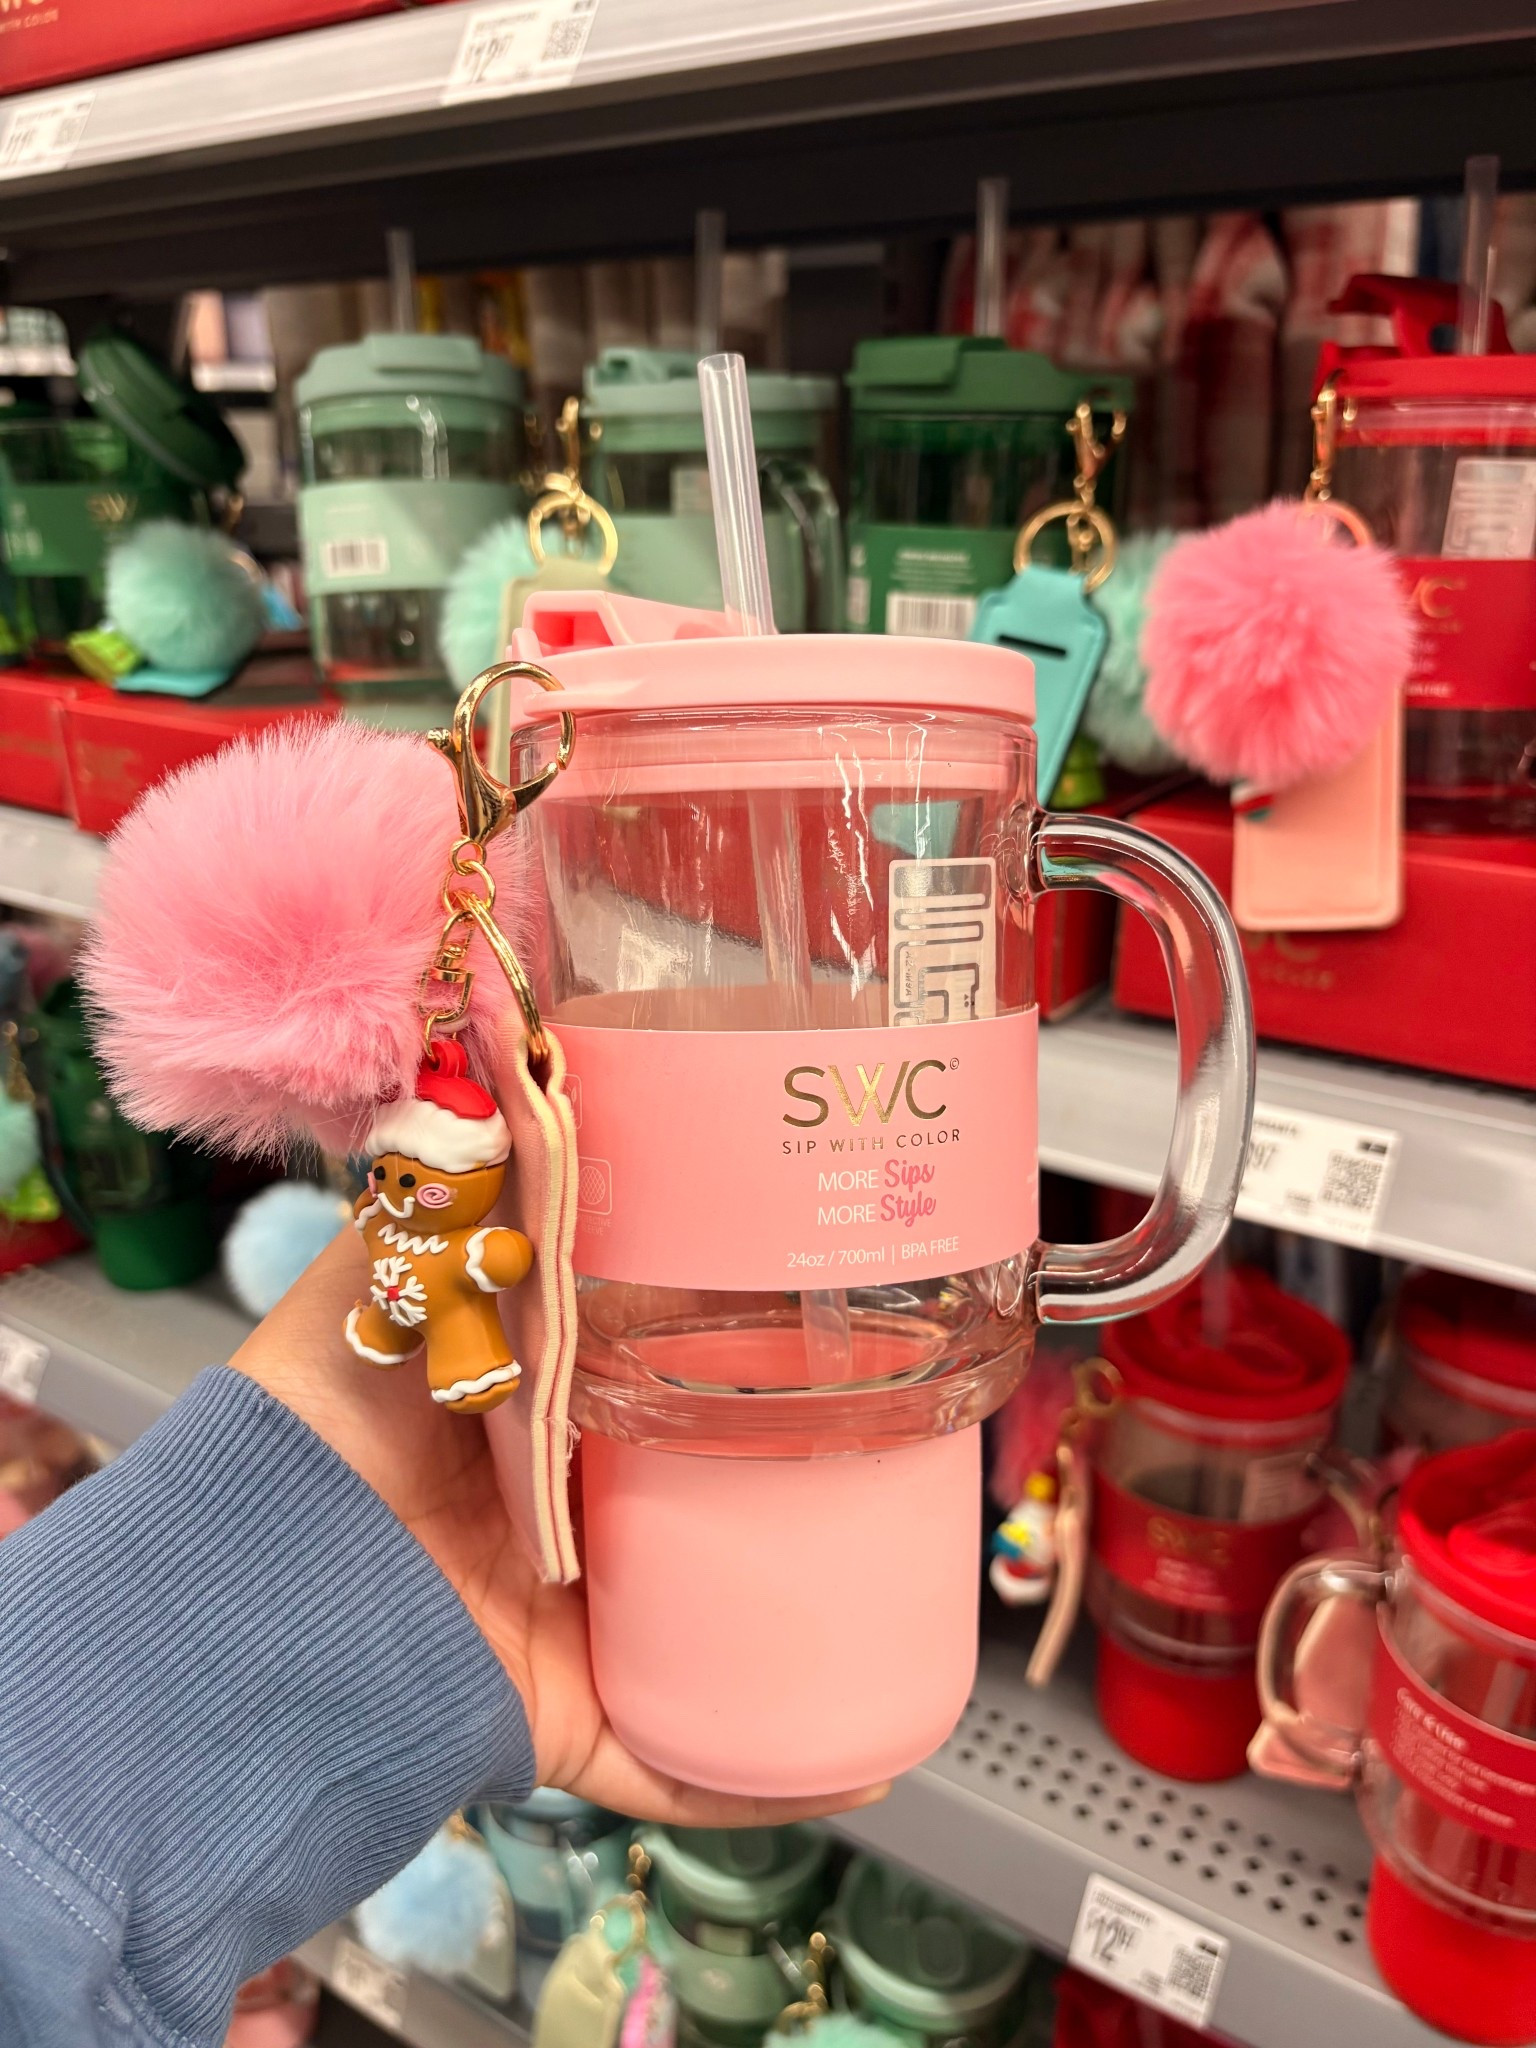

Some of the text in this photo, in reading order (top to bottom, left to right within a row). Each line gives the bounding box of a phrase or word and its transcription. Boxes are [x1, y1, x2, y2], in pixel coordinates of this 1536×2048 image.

[782, 1129, 960, 1154] SIP WITH COLOR
[818, 1159, 935, 1193] MORE Sips
[817, 1190, 937, 1228] MORE Style
[787, 1252, 826, 1268] 24oz
[838, 1246, 885, 1265] 700ml
[901, 1242, 928, 1260] BPA
[930, 1236, 959, 1255] FREE
